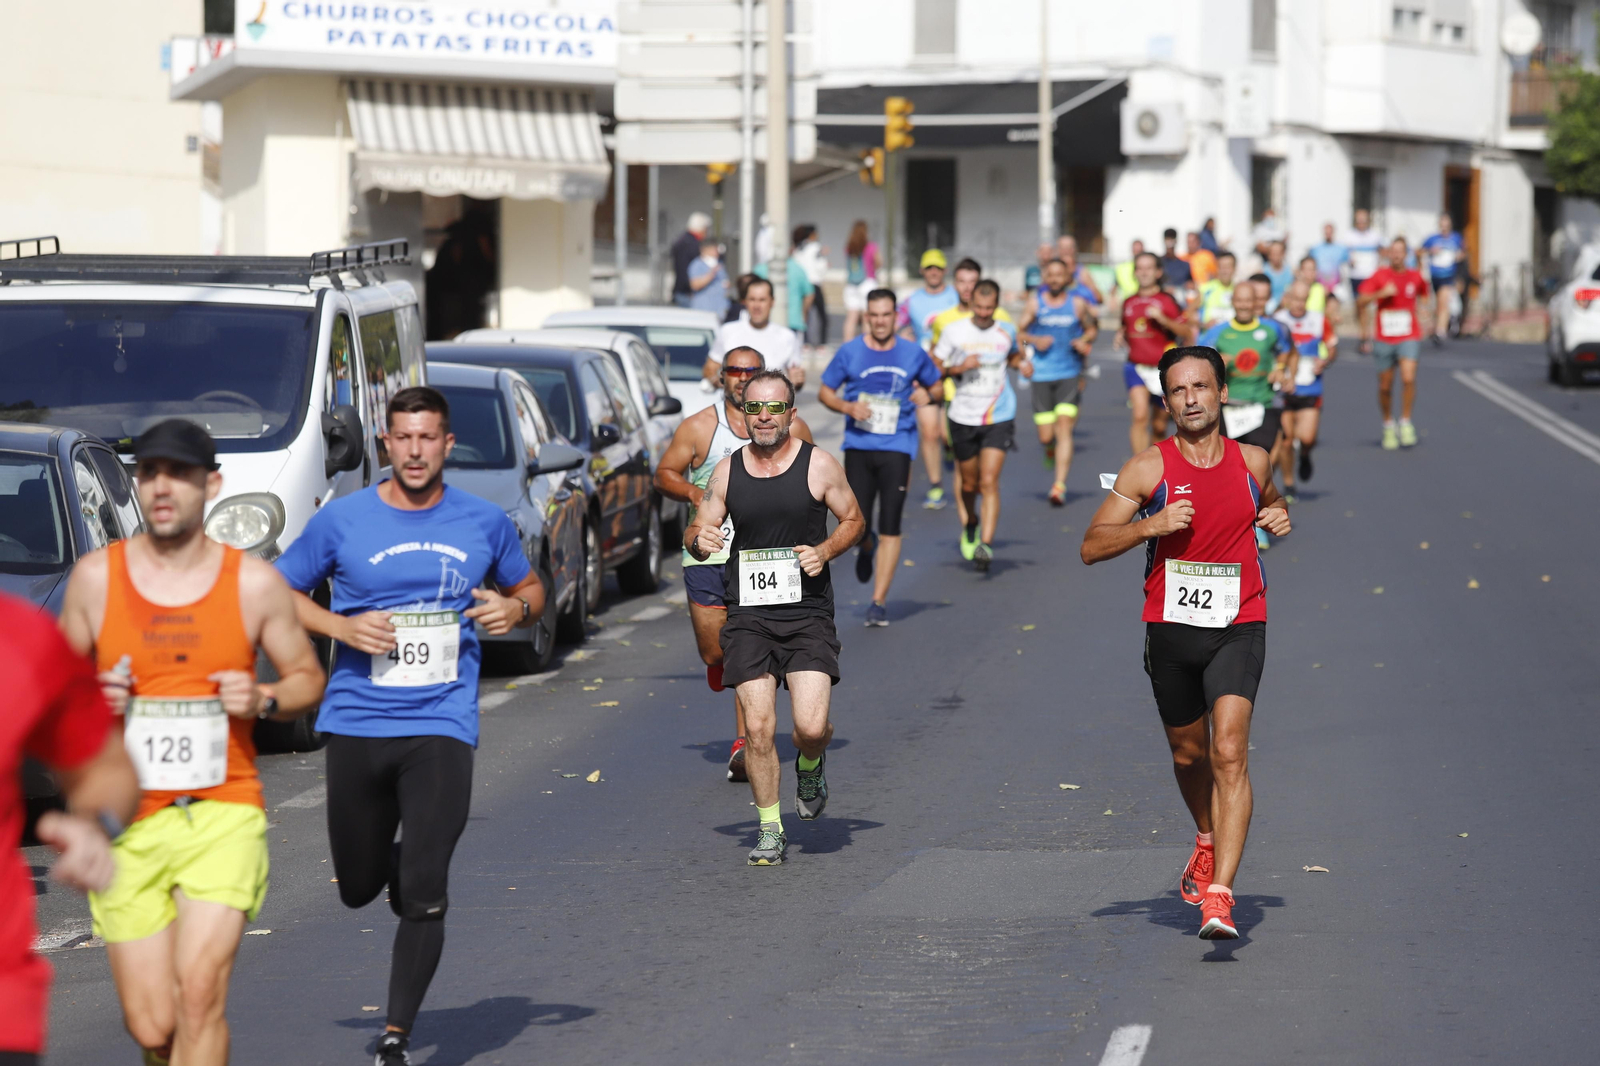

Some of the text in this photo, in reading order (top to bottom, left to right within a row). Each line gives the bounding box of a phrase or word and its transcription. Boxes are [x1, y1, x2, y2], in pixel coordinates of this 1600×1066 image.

[283, 1, 434, 25] CHURROS
[466, 10, 616, 33] CHOCOLA
[327, 28, 594, 58] PATATAS FRITAS
[422, 541, 431, 551] A
[749, 551, 767, 561] VUELTA
[768, 551, 773, 560] A
[773, 550, 795, 560] HUELVA
[1170, 563, 1236, 576] 34 VUELTA A HUELVA
[749, 571, 778, 591] 184
[1177, 586, 1213, 610] 242
[419, 615, 426, 627] A
[426, 612, 454, 627] HUELVA
[387, 642, 430, 665] 469
[143, 736, 193, 763] 128
